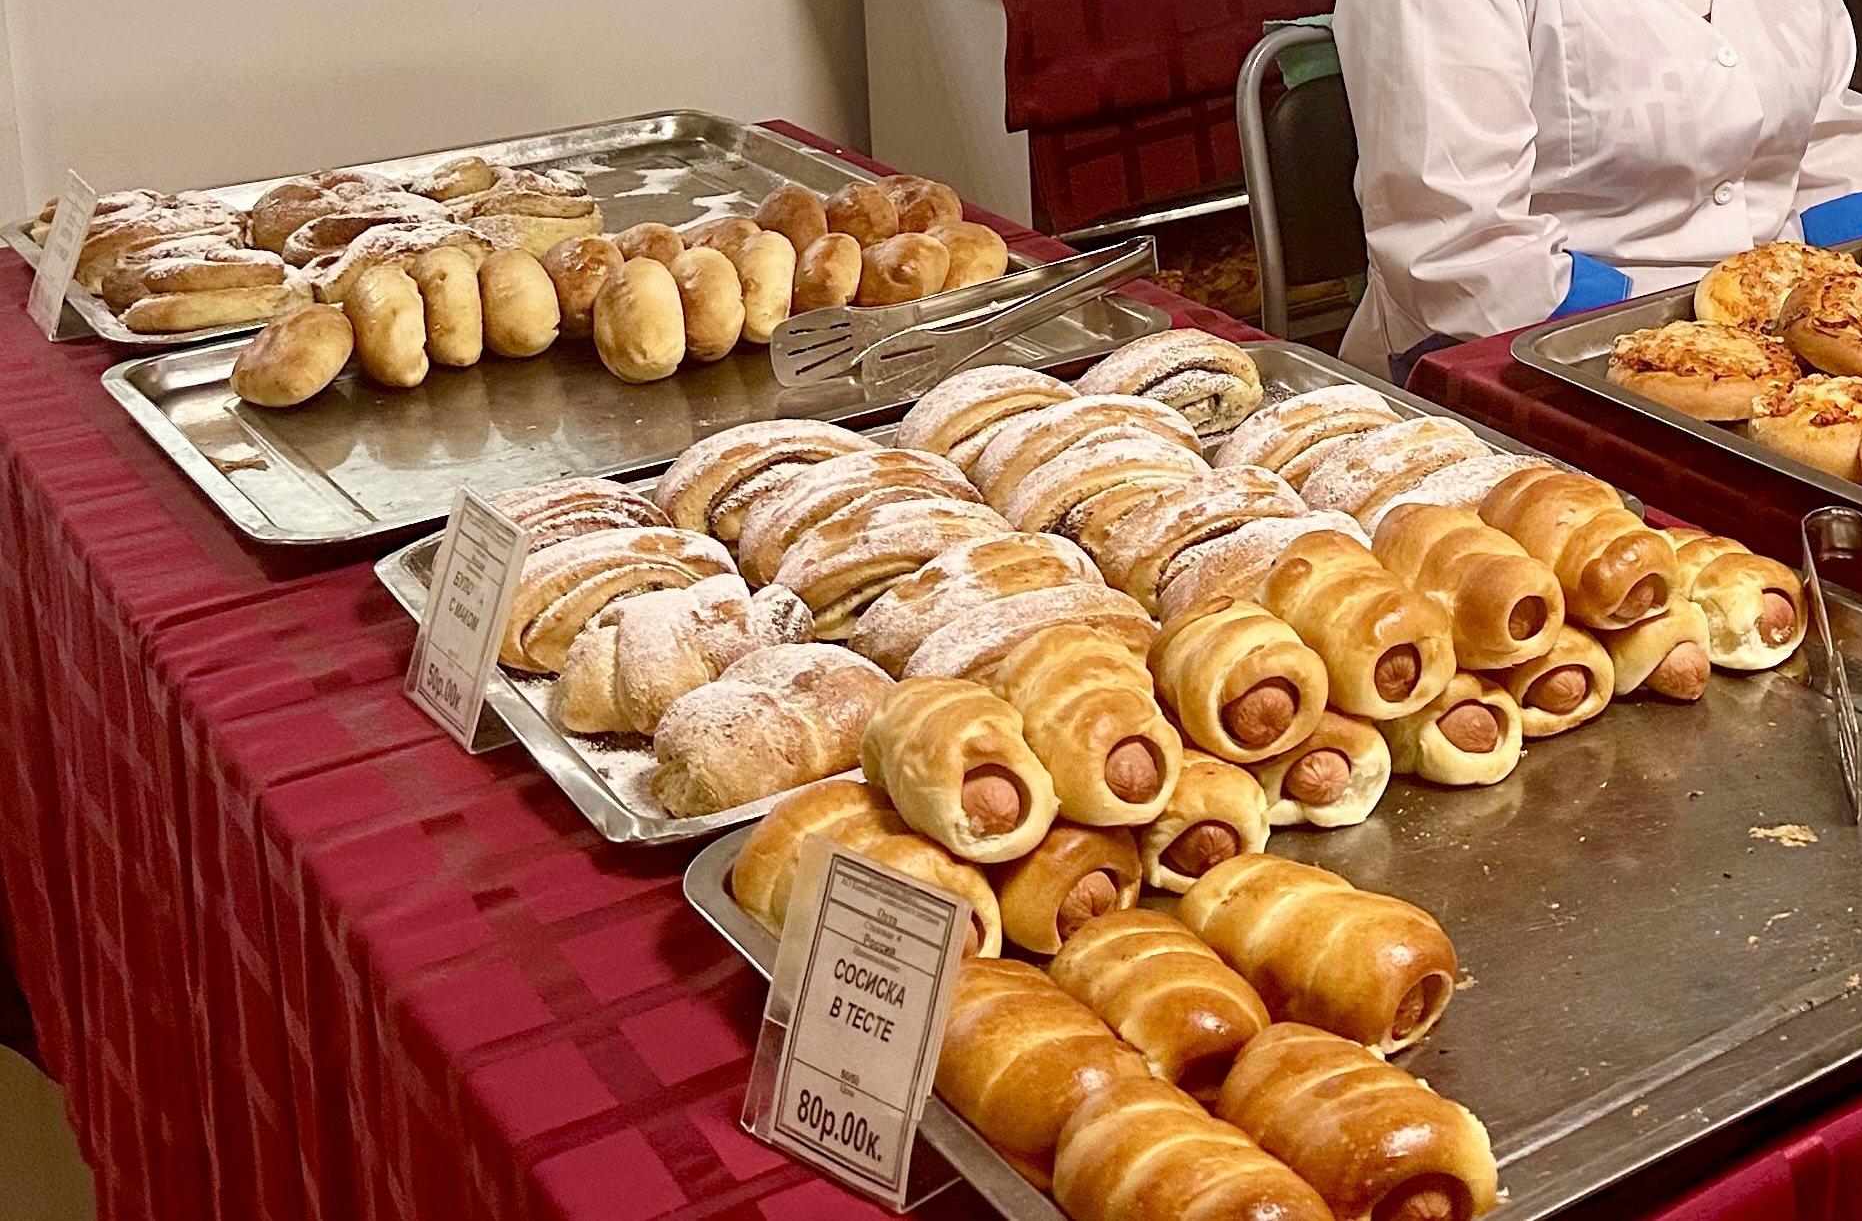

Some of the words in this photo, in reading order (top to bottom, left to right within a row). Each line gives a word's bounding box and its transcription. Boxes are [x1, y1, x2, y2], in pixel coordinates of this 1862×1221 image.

[834, 958, 906, 1009] СОСИСКА
[829, 996, 843, 1018] В
[845, 1002, 895, 1042] ТЕСТЕ
[797, 1089, 882, 1162] 80р.00к.
